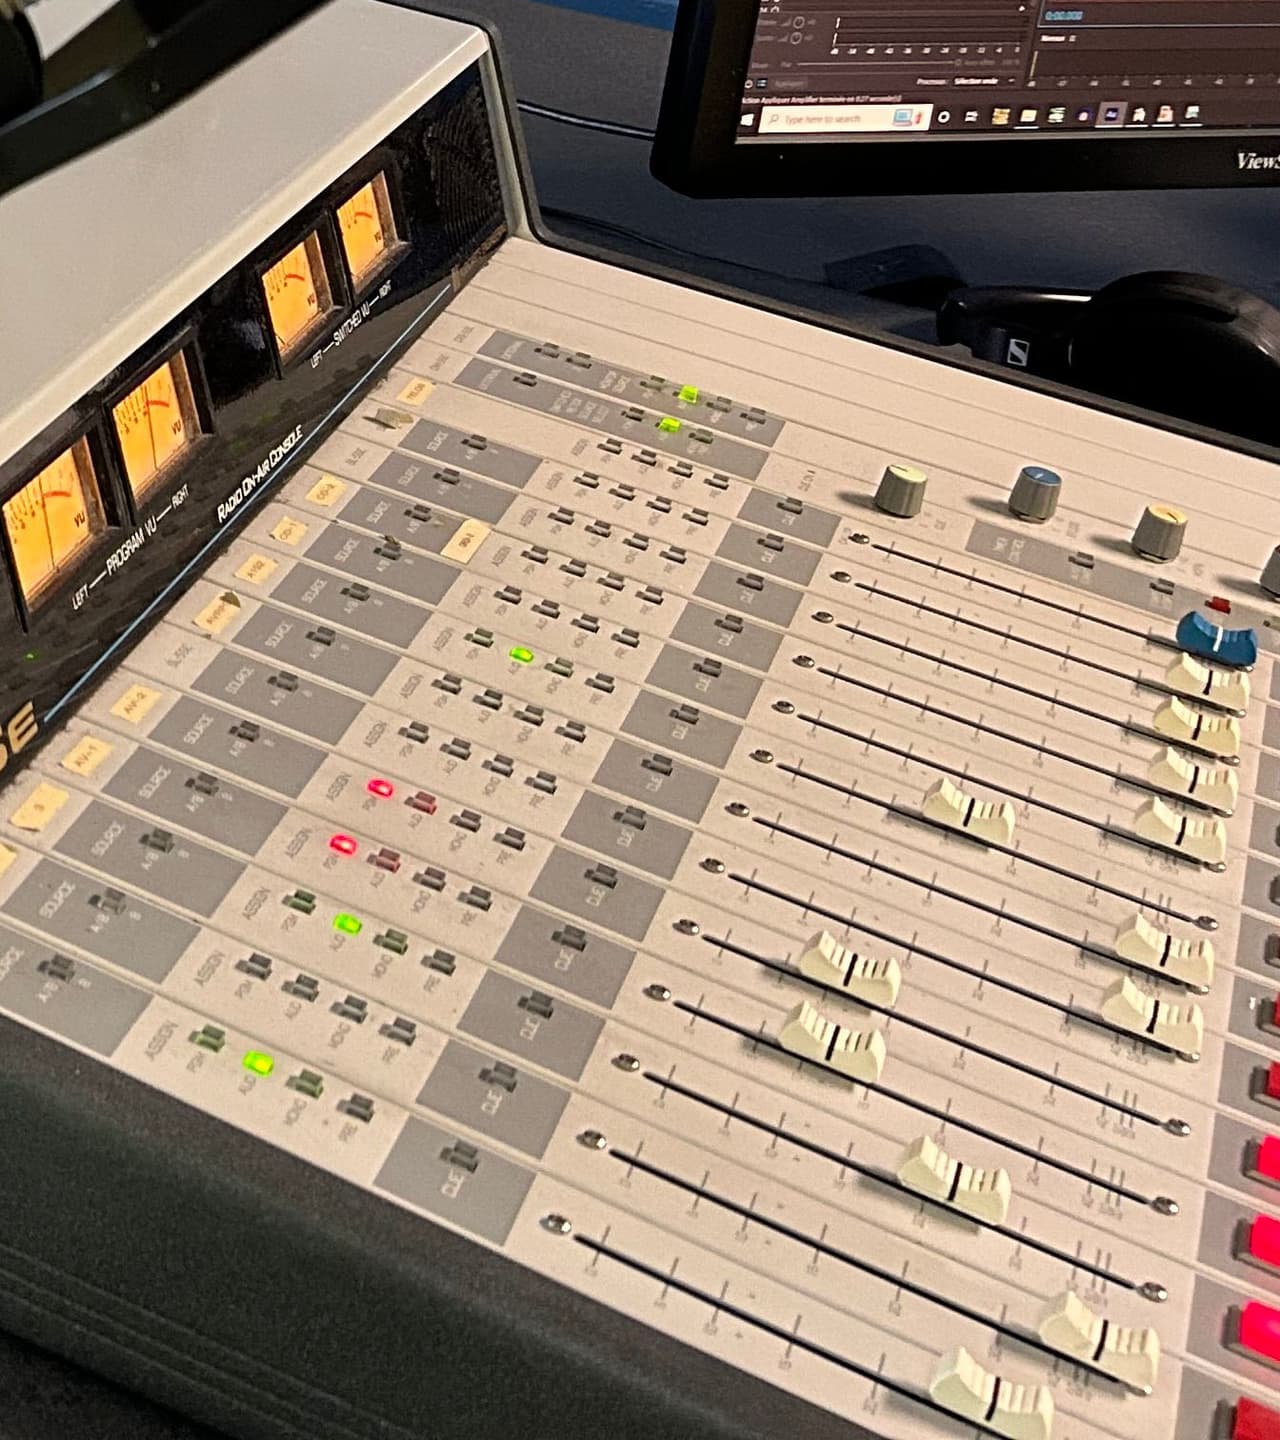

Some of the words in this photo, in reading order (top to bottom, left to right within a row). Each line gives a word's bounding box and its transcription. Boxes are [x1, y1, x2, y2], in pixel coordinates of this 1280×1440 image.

[785, 116, 800, 125] Type
[801, 115, 822, 123] here
[824, 115, 834, 123] to
[836, 115, 861, 123] search
[311, 349, 323, 368] LEFT
[334, 311, 362, 346] SWITCHED
[361, 301, 370, 320] VU
[379, 279, 392, 298] RIGHT
[171, 418, 183, 435] VU
[217, 495, 243, 524] RADIO
[243, 459, 271, 498] ON-AIR
[269, 424, 303, 466] CONSOLE
[74, 512, 86, 528] VU
[72, 579, 89, 610] LEFT
[106, 527, 145, 577] PROGRAM
[145, 515, 157, 537] VU
[172, 484, 189, 509] RIGHT
[182, 713, 217, 745] SOURCE
[70, 742, 100, 768] AV-1
[137, 765, 174, 799] SOURCE
[89, 819, 129, 857] SOURCE
[37, 879, 79, 919] SOURCE
[191, 949, 227, 988] ASSIGN
[140, 1019, 179, 1062] ASSIGN
[481, 1089, 506, 1116] CUE
[440, 1169, 466, 1199] CUE
